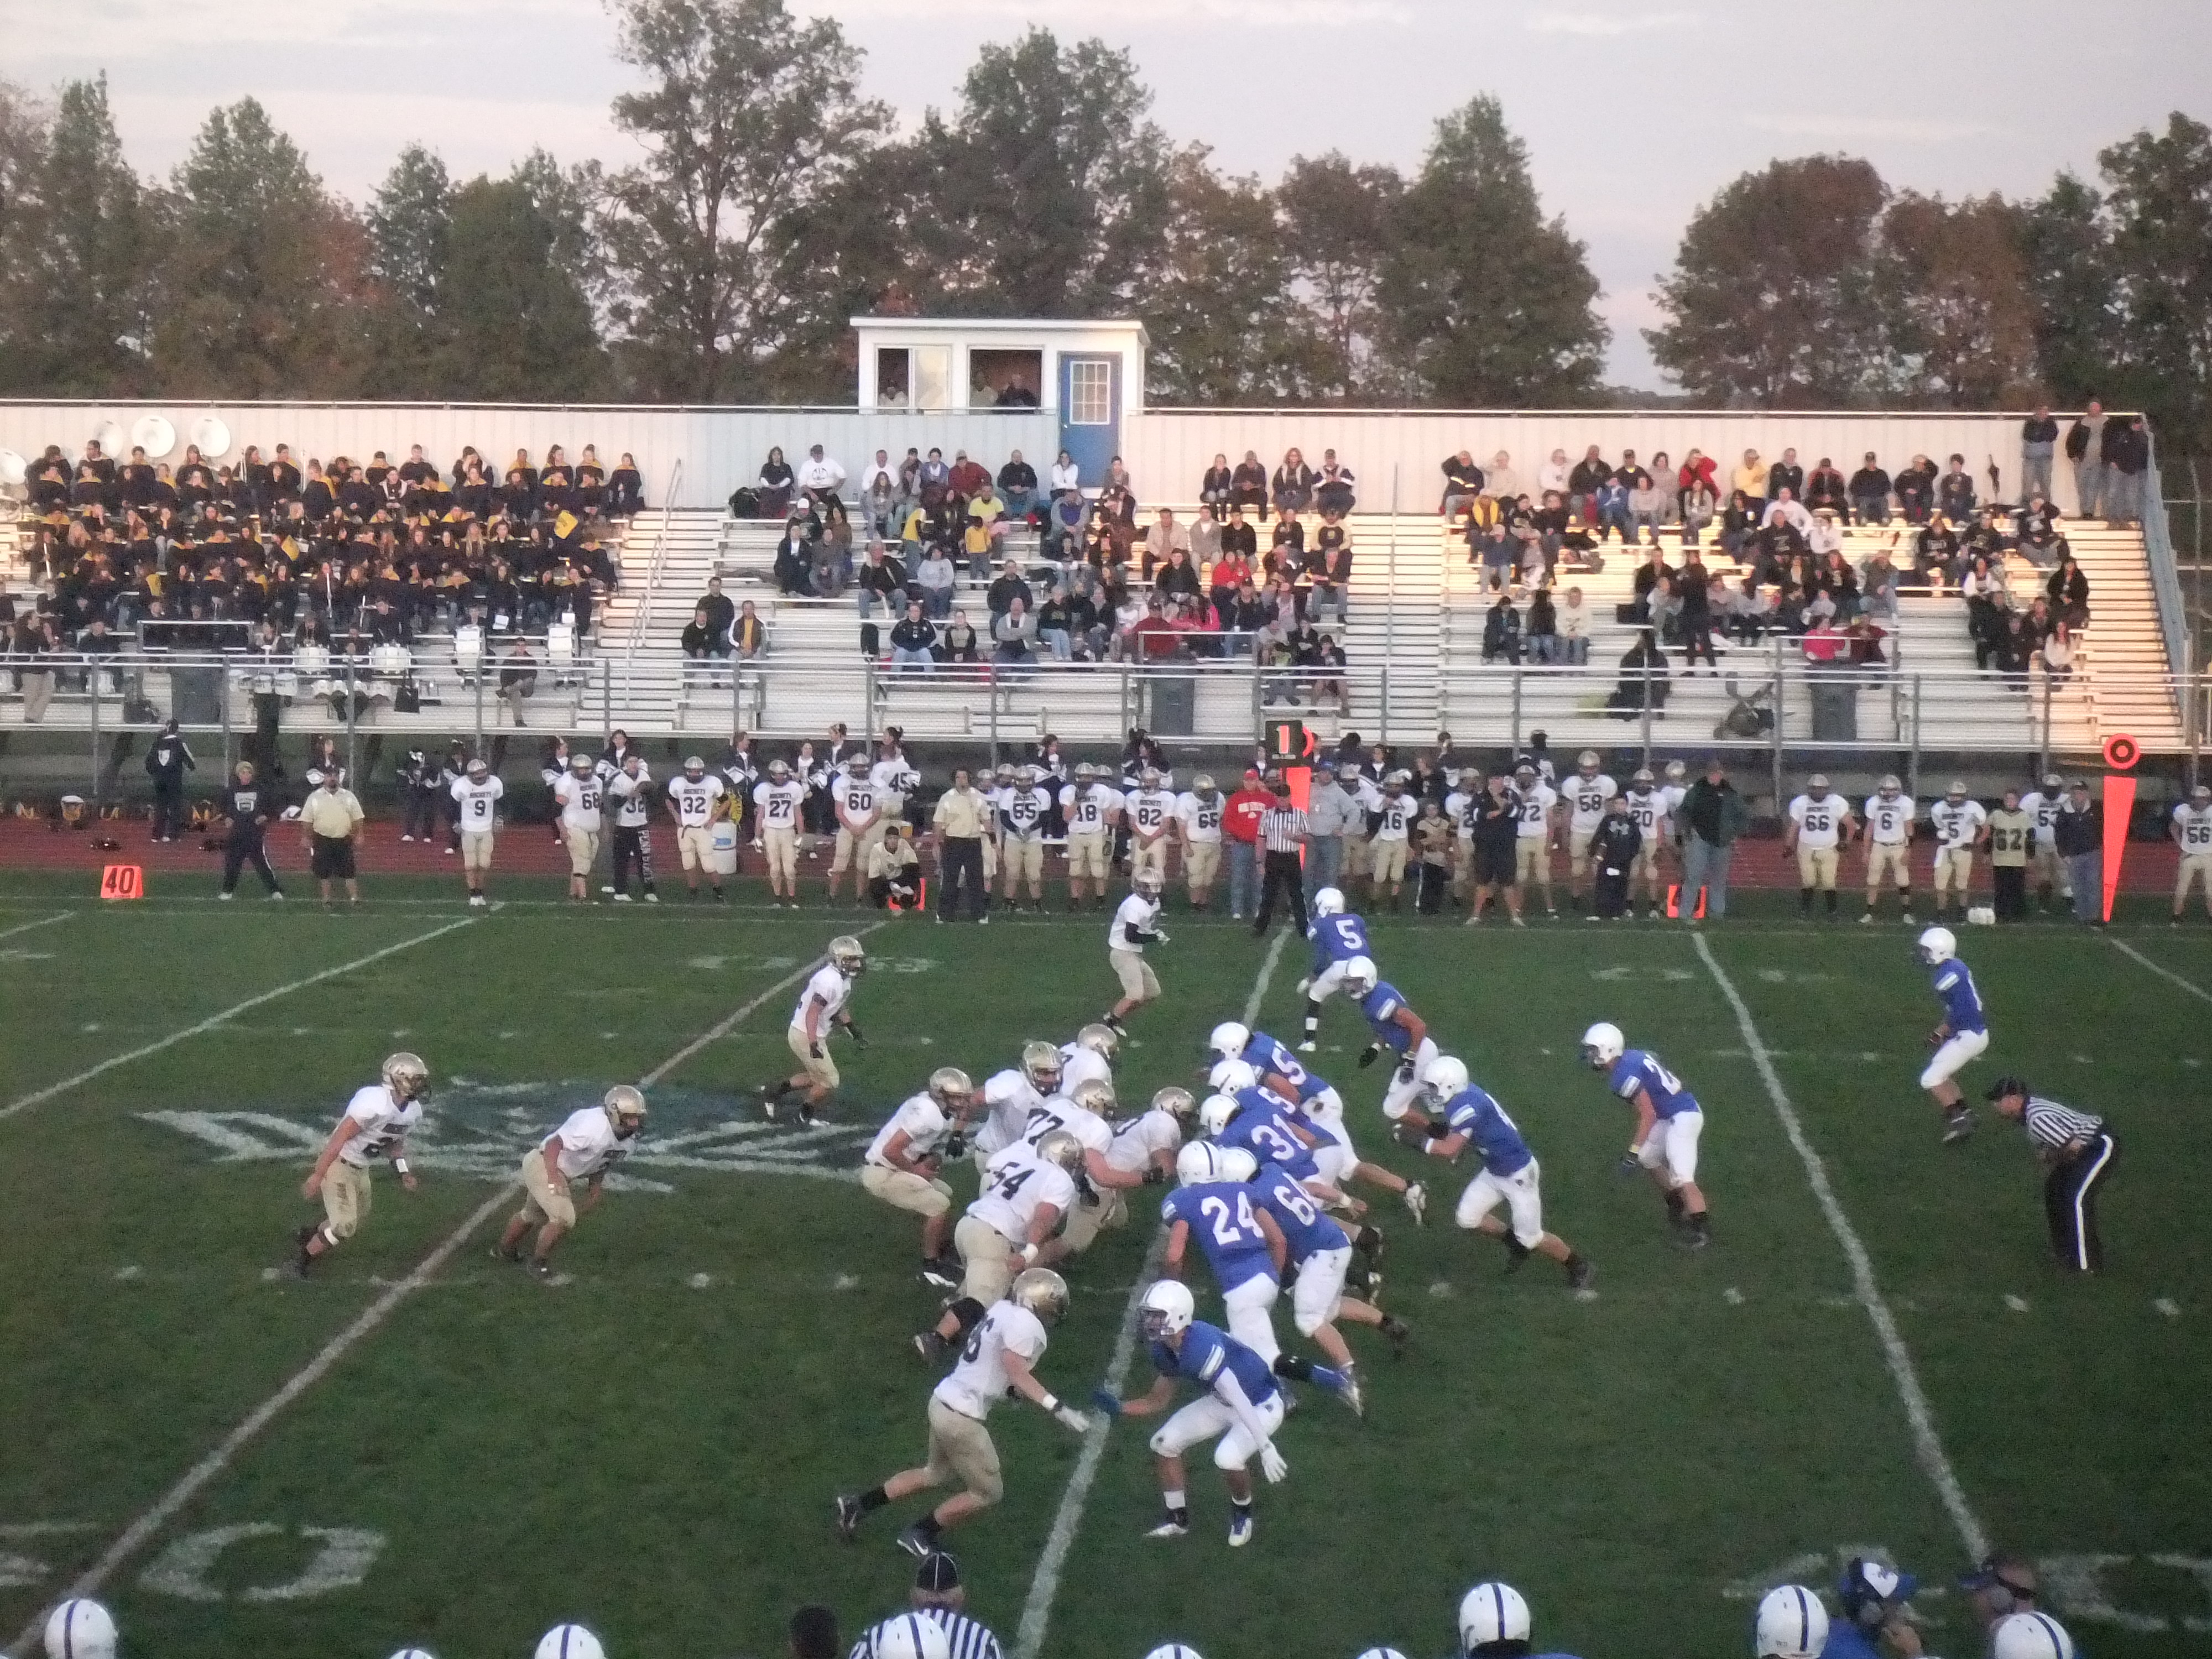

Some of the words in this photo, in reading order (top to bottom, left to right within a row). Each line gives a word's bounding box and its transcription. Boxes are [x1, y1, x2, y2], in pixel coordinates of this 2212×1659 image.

[1276, 725, 1290, 754] 1
[474, 800, 486, 816] 9
[582, 792, 600, 811] 68
[684, 796, 706, 814] 32
[769, 800, 791, 818] 27
[848, 792, 872, 811] 60
[1579, 794, 1603, 812] 58
[1076, 804, 1097, 822] 18
[1139, 808, 1161, 826] 82
[1881, 812, 1892, 830] 6
[1948, 821, 1959, 839] 5
[2187, 827, 2210, 843] 56
[105, 867, 134, 894] 40
[1335, 919, 1363, 950] 5
[1250, 1114, 1308, 1160] 31
[1201, 1191, 1264, 1245] 24
